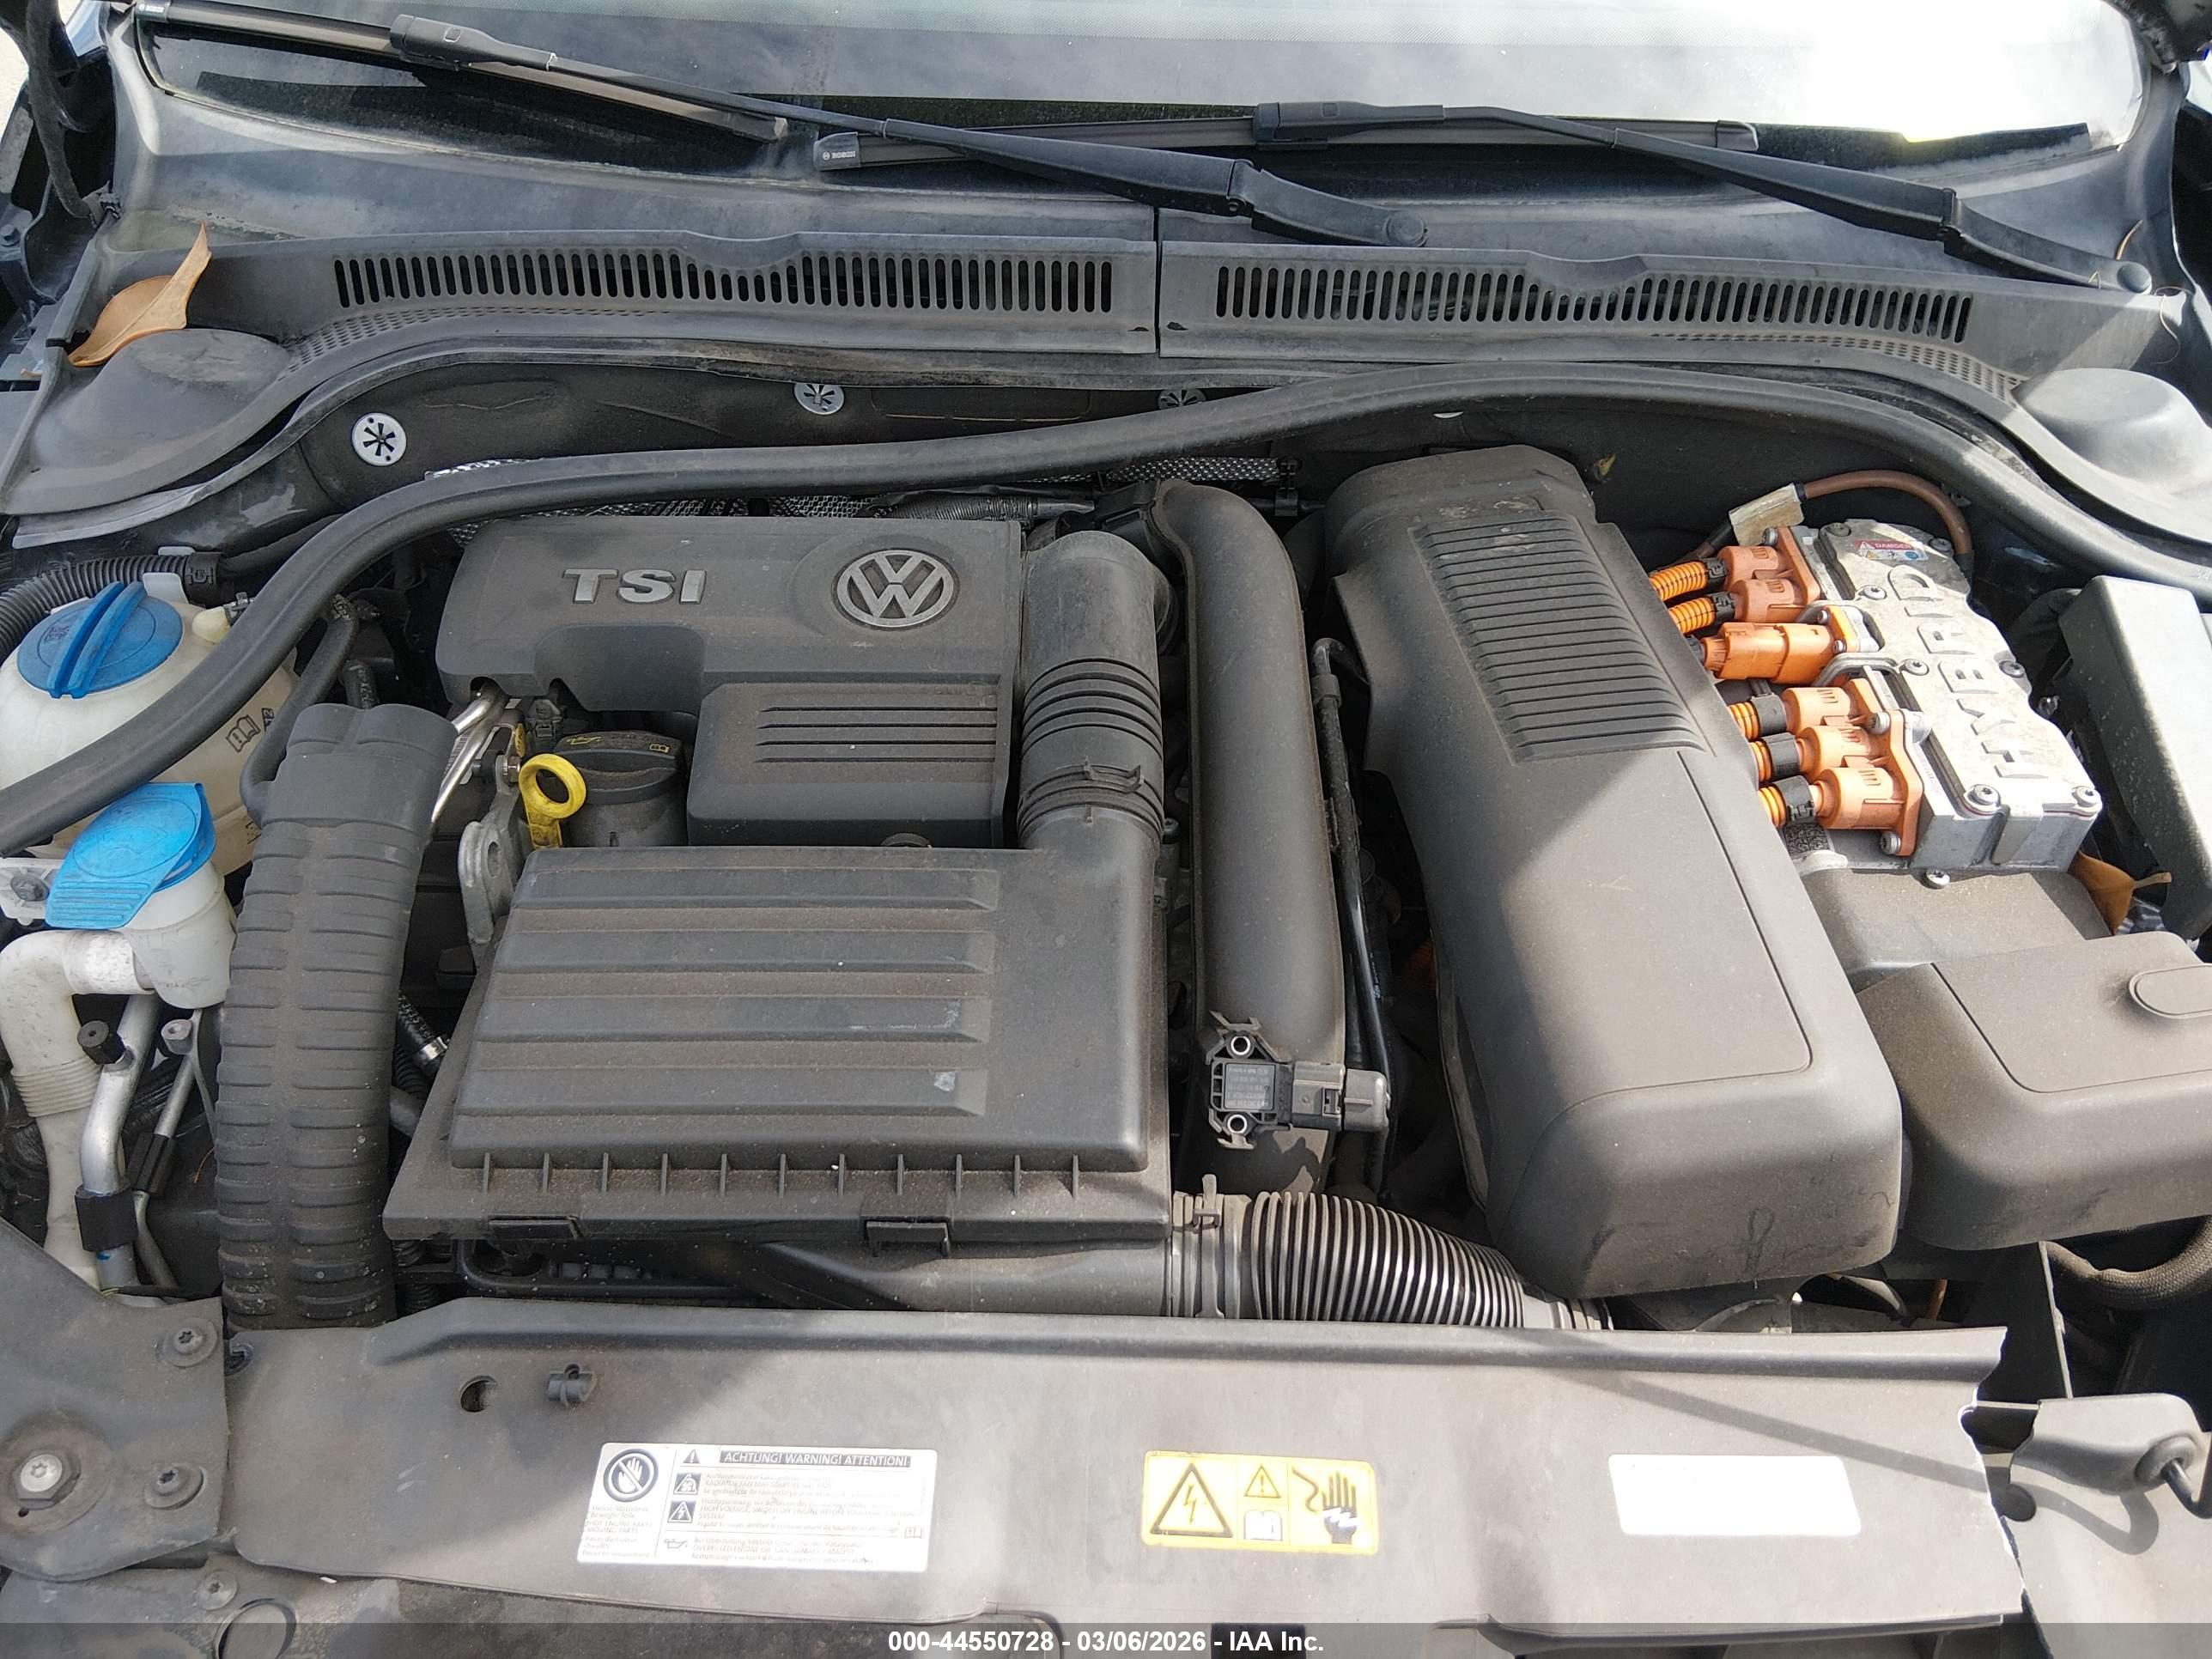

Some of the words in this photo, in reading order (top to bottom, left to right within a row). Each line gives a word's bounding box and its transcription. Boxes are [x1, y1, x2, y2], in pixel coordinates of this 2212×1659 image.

[563, 568, 707, 604] TSI
[1887, 565, 2050, 779] HYBRID
[724, 1452, 782, 1463] ACHTUNG!
[785, 1454, 842, 1465] WARNING!
[844, 1455, 908, 1467] ATTENTION!
